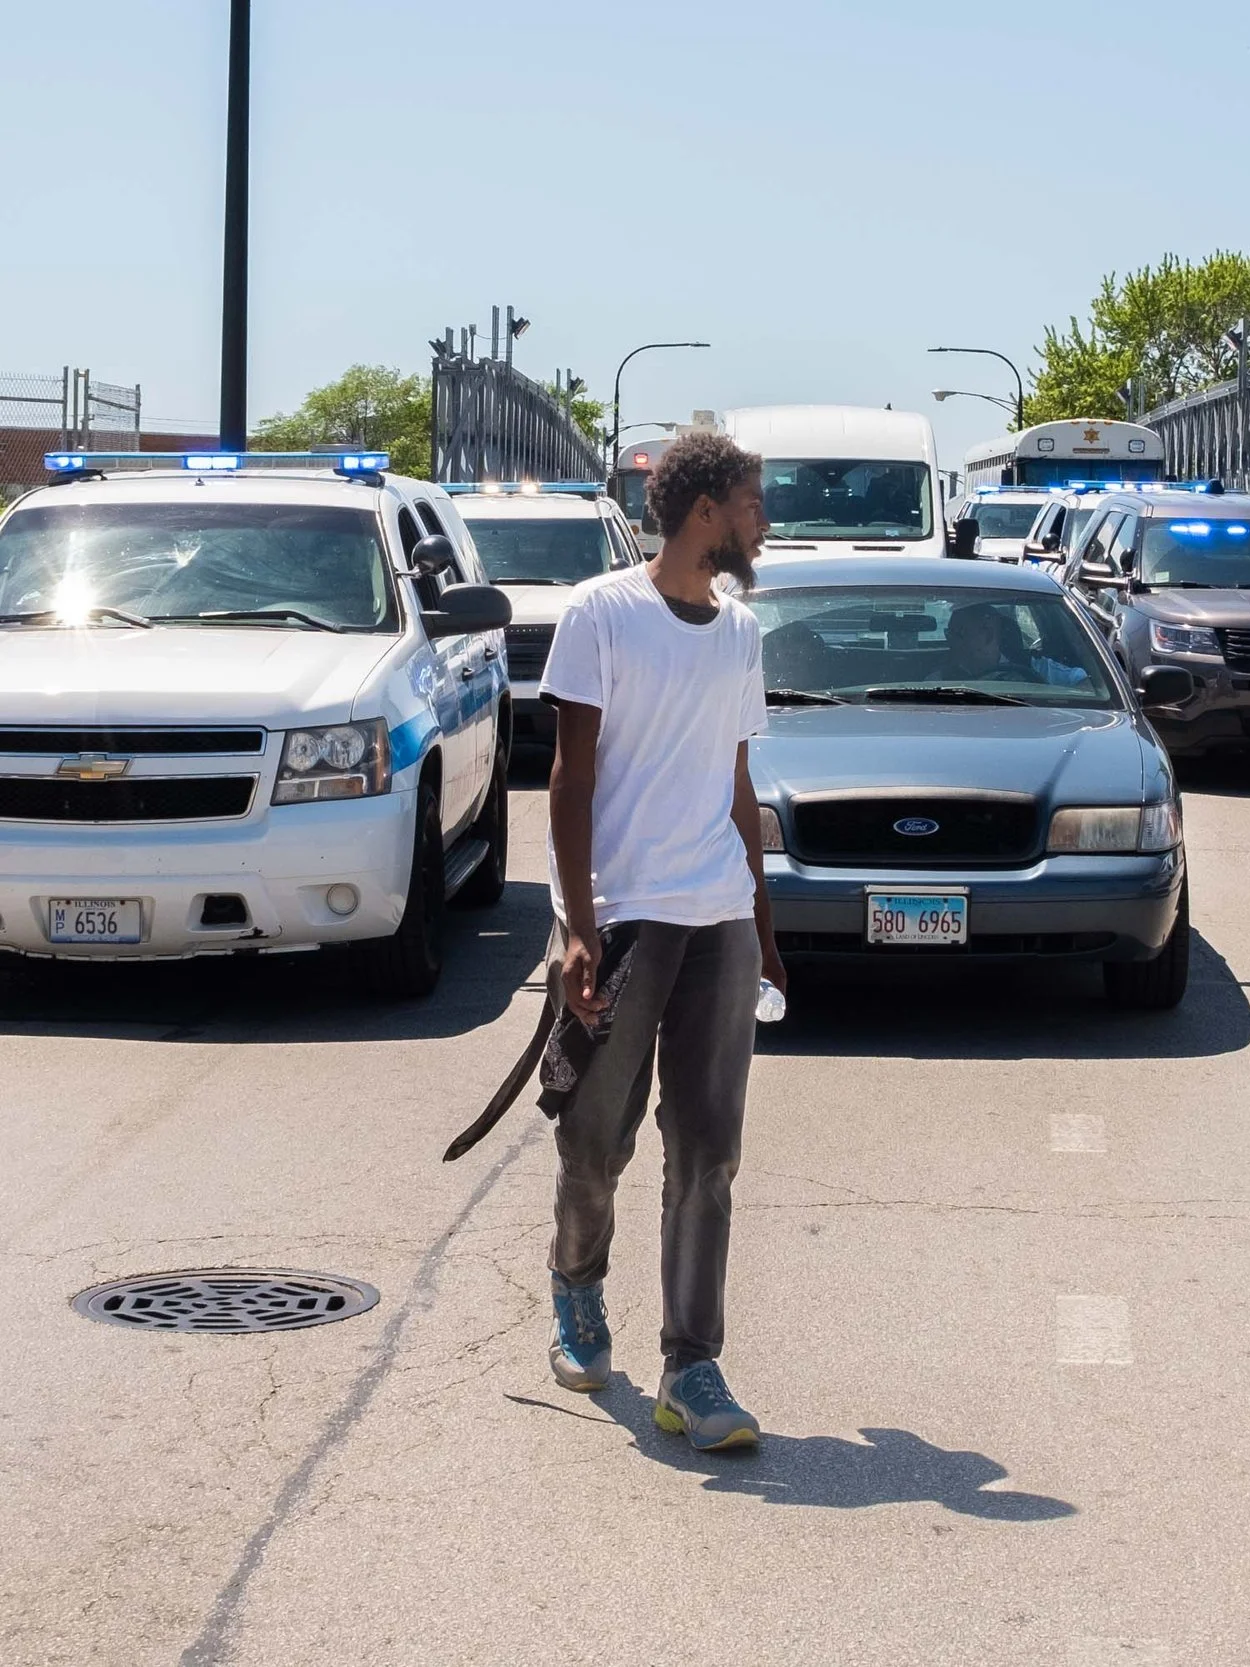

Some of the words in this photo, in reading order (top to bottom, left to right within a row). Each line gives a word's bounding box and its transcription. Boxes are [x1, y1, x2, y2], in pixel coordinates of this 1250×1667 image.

[75, 911, 118, 935] 6536
[873, 910, 905, 933] 580
[918, 910, 962, 934] 6965
